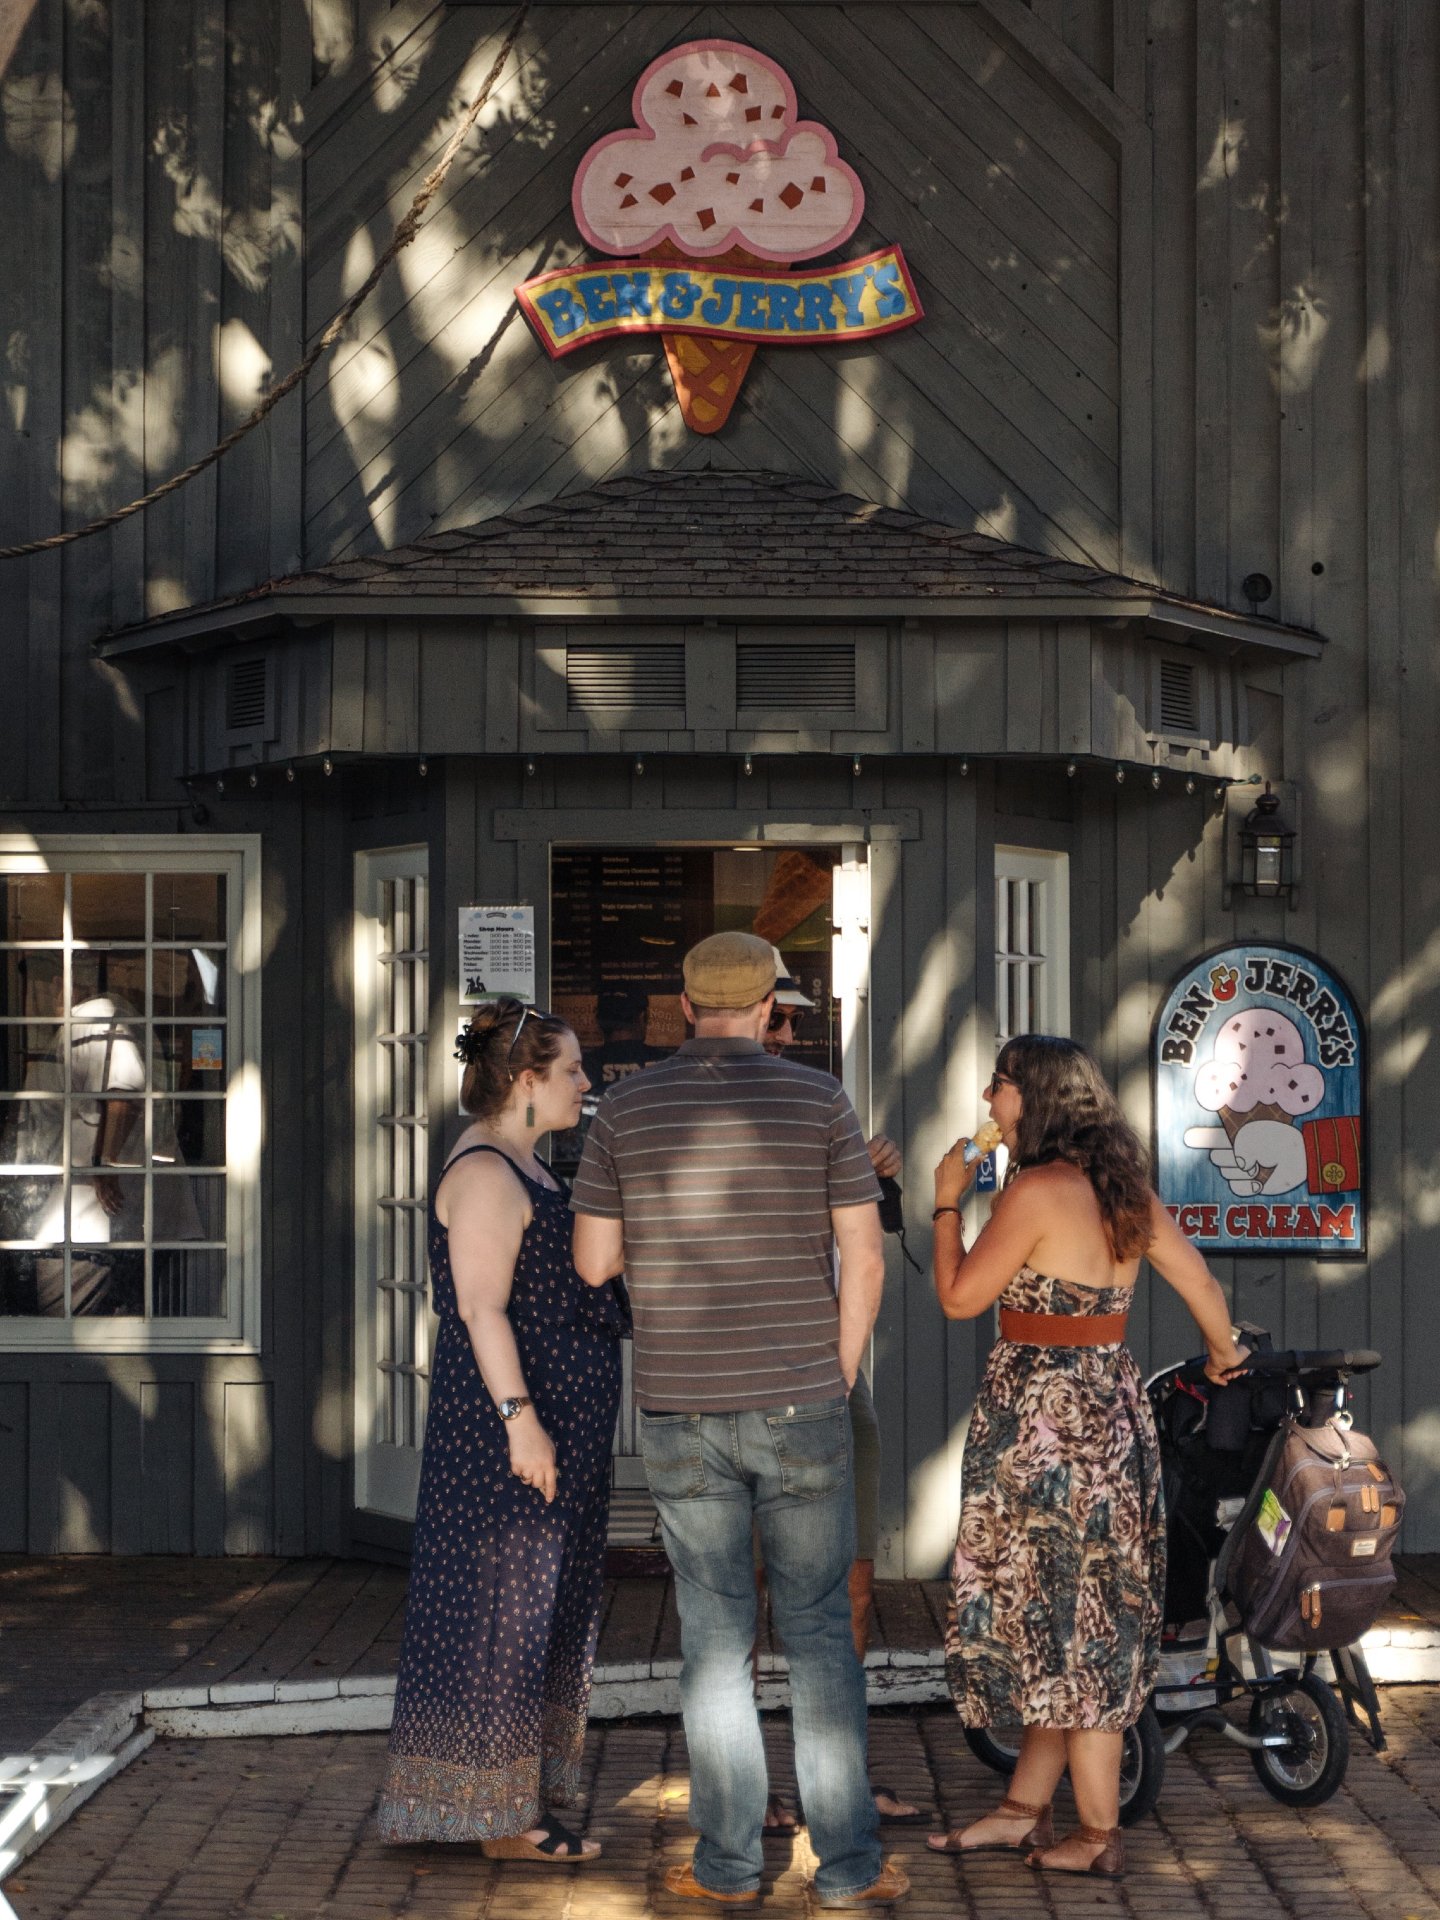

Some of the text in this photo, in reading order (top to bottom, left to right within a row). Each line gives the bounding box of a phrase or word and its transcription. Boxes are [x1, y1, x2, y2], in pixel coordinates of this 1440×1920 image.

[536, 263, 908, 338] BEN & JERRY'S
[1161, 957, 1357, 1068] BEN & JERRY'S
[1226, 1204, 1356, 1240] CREAM
